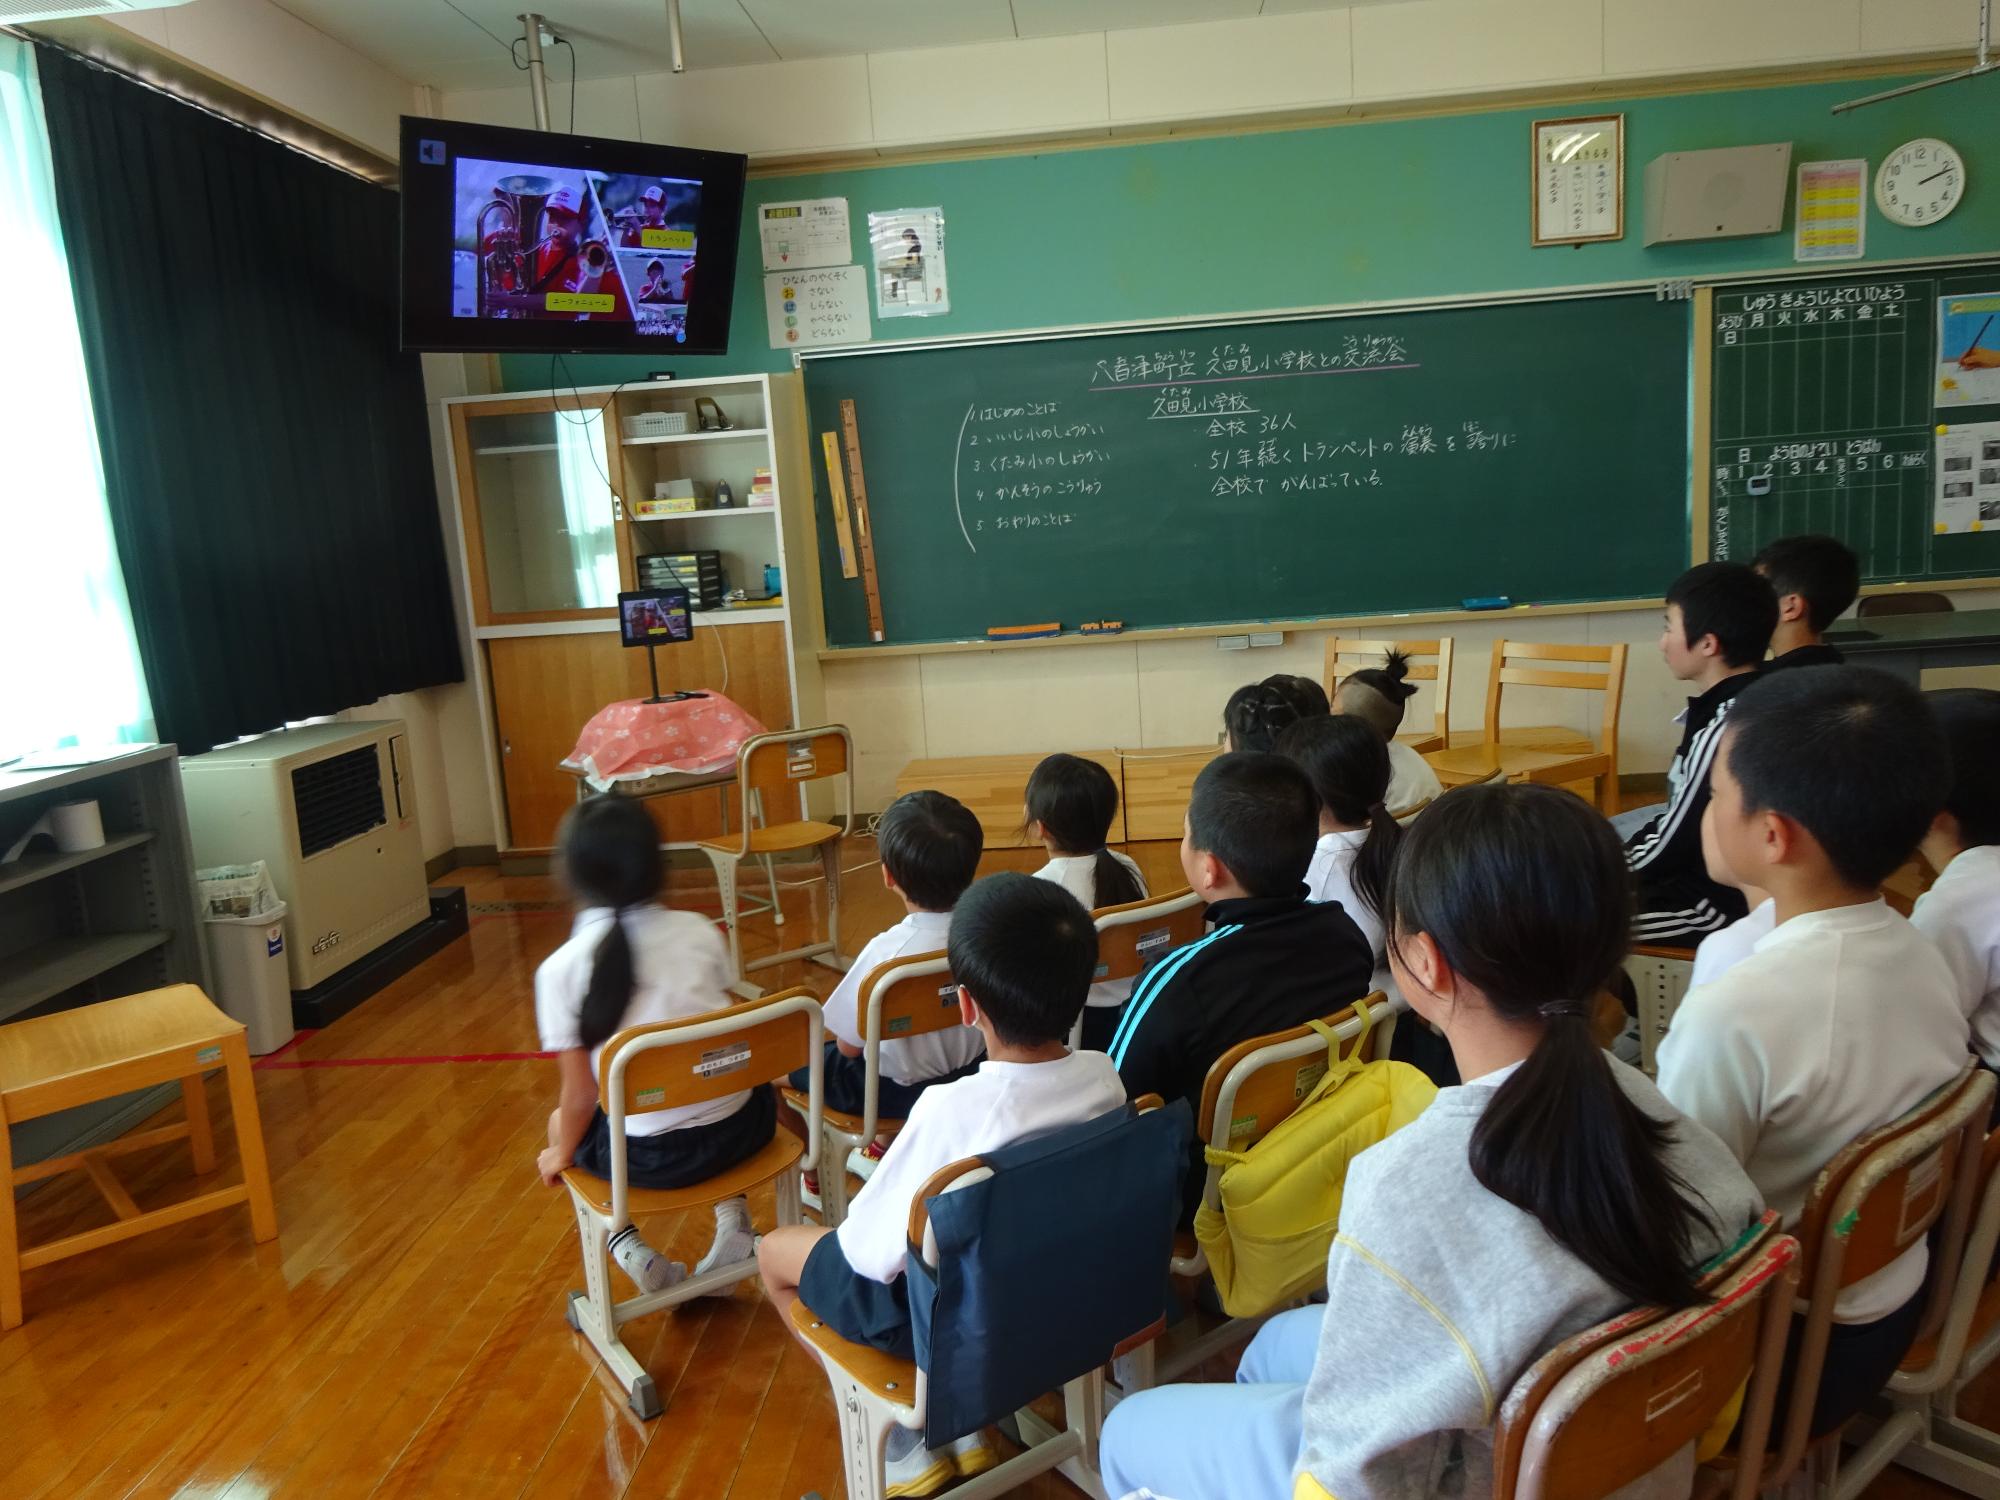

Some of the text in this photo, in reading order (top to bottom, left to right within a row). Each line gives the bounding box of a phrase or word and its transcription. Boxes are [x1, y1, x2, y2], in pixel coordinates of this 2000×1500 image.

[1902, 153, 1911, 164] 11
[1915, 146, 1926, 159] 12
[1932, 149, 1938, 162] 1
[1890, 164, 1901, 176] 10
[1942, 160, 1952, 171] 2
[1886, 180, 1896, 191] 9
[1946, 174, 1954, 186] 3
[1890, 194, 1898, 206] 8
[1941, 190, 1949, 201] 4
[1902, 203, 1910, 215] 7
[1915, 206, 1924, 218] 6
[1930, 201, 1938, 213] 5
[783, 271, 848, 286] ひなんのやくそく
[808, 287, 834, 297] さない
[810, 299, 844, 310] しらない
[1718, 303, 1900, 330] ようび 月 火 水 木 金 土
[1724, 331, 1737, 345] 日
[1211, 343, 1251, 357] くたみ
[1152, 391, 1251, 417] 久田見小学校
[1206, 412, 1298, 438] 全校 36人
[991, 449, 1111, 472] くたみ小のしょうかい
[1738, 447, 1751, 463] 日
[1738, 465, 1744, 479] 1
[1762, 463, 1774, 477] 2
[1790, 461, 1801, 475] 3
[1815, 459, 1829, 473] 4
[1856, 456, 1868, 471] 5
[1883, 454, 1894, 469] 6
[1211, 475, 1269, 497] 全校で
[976, 489, 984, 501] 4
[976, 519, 985, 531] 5
